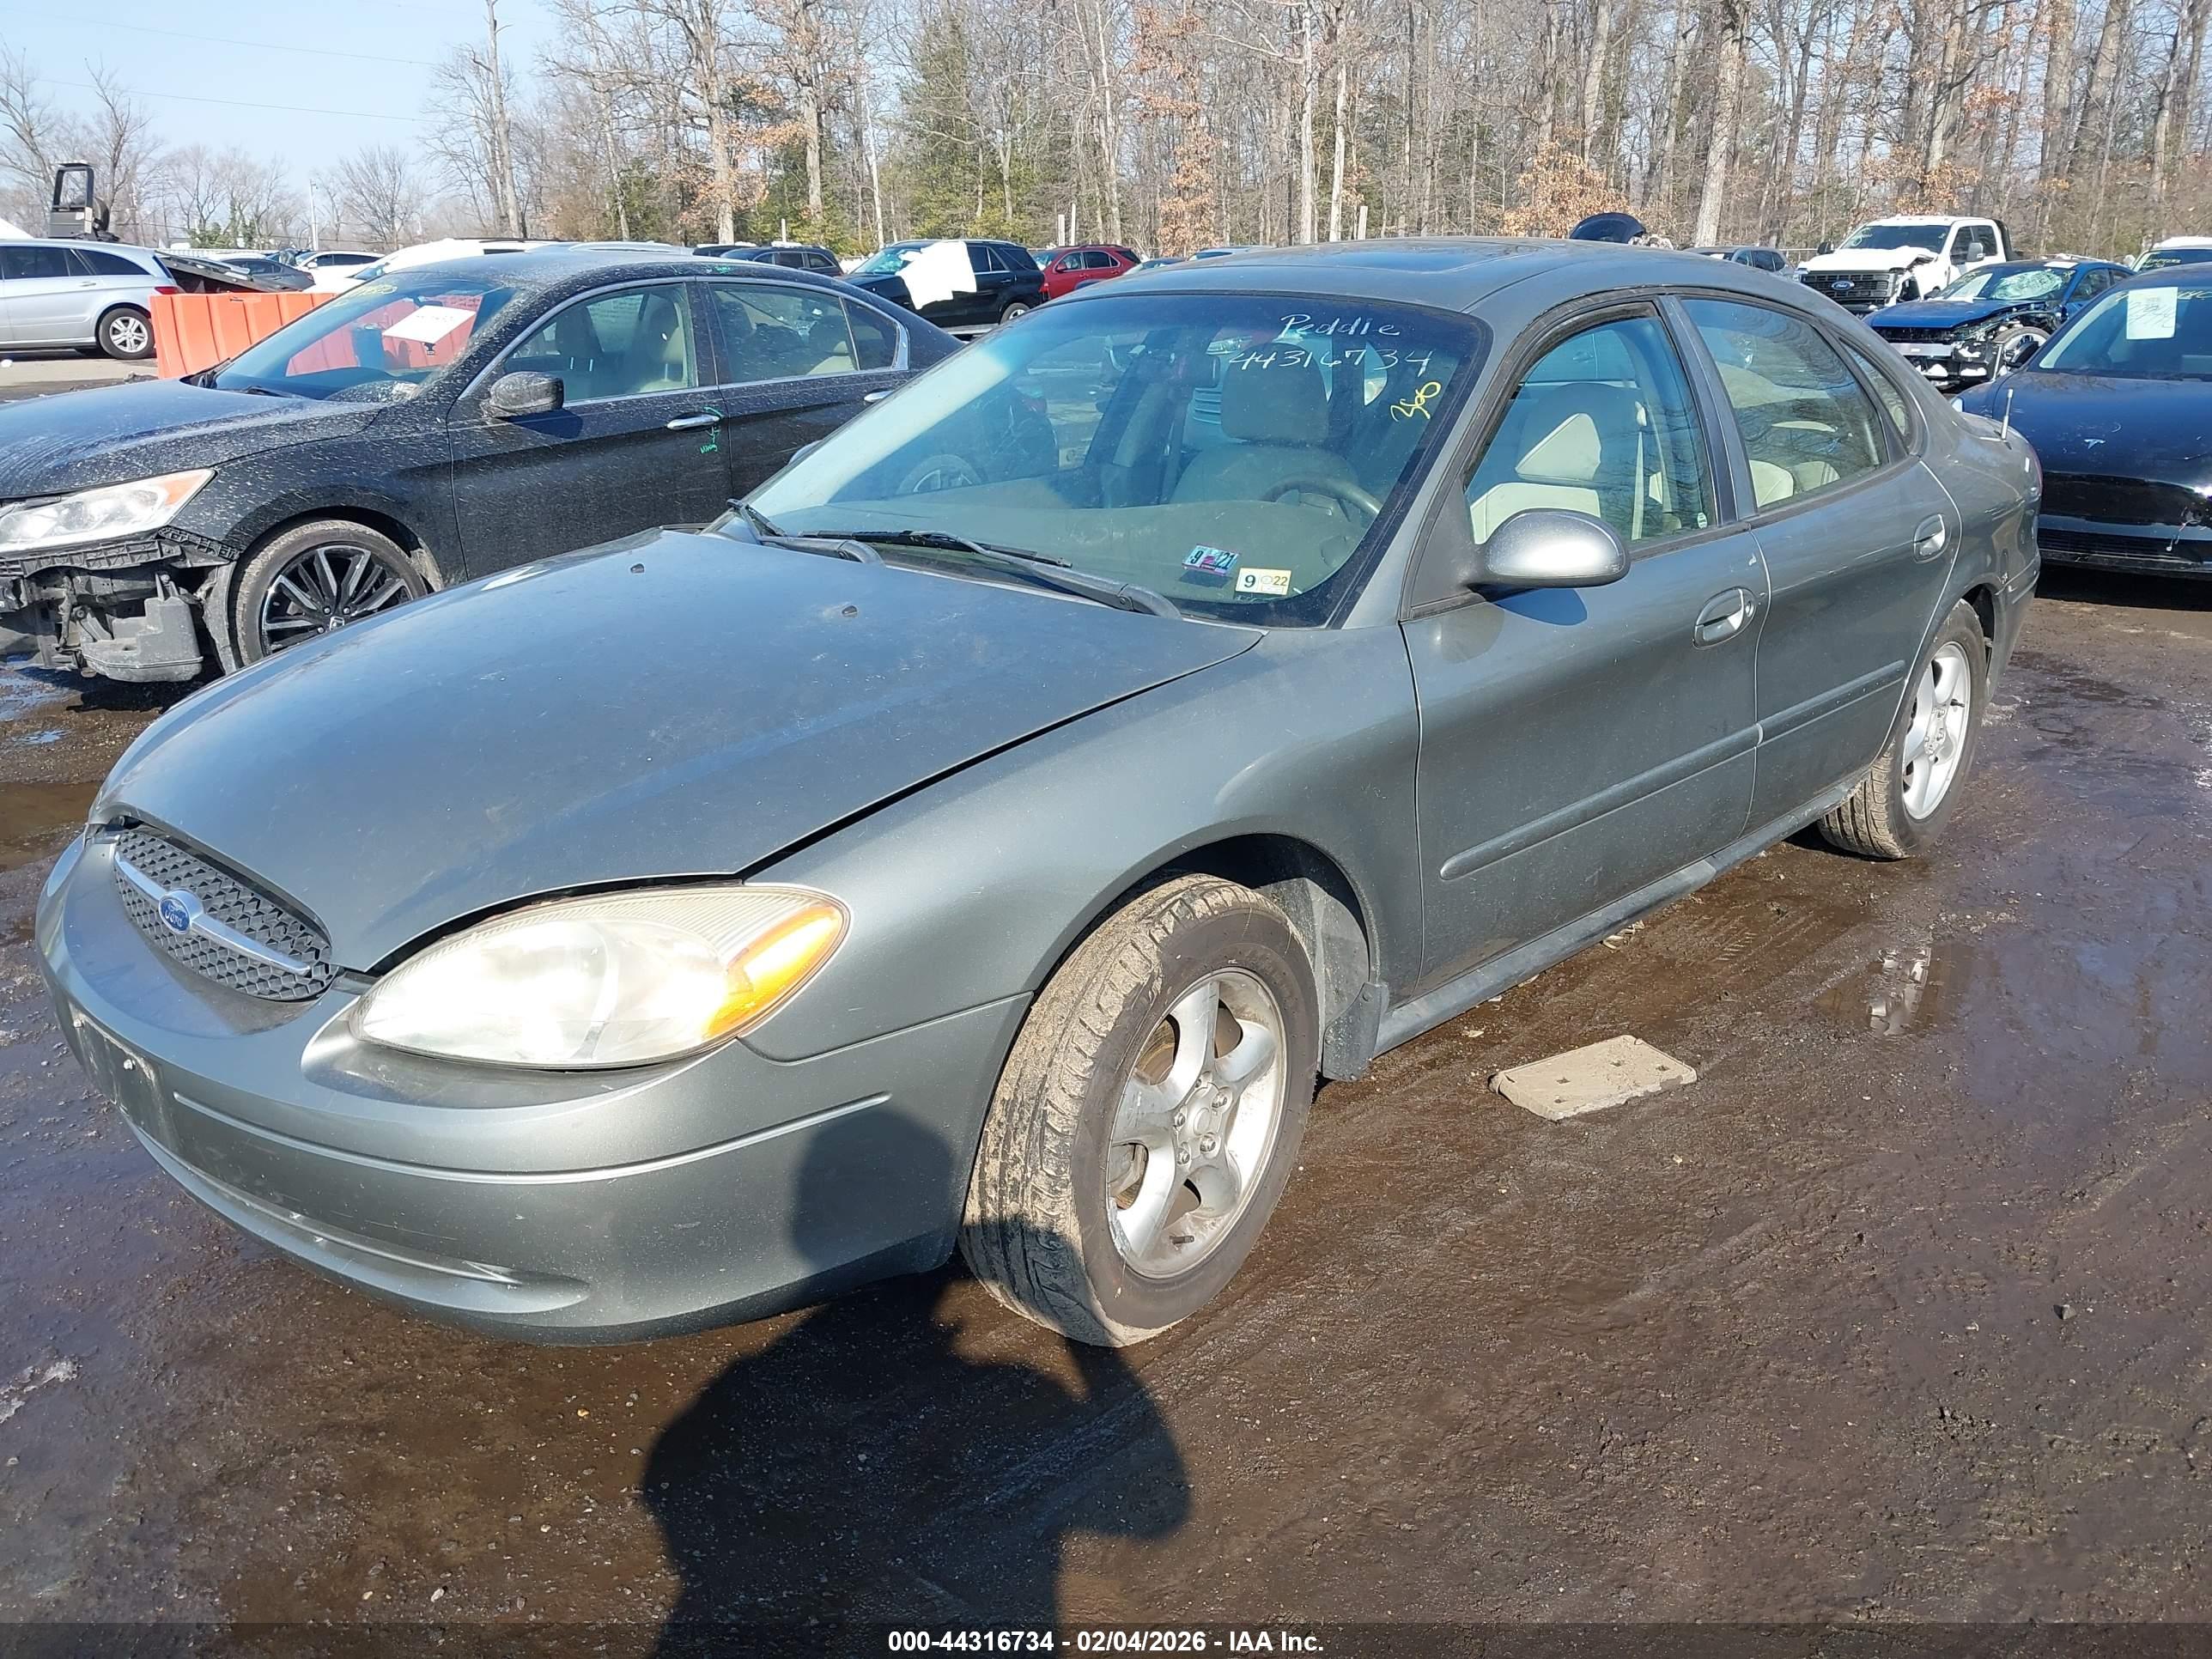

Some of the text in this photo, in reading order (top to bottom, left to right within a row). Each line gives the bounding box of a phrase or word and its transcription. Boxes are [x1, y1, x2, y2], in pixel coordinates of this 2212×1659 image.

[1229, 348, 1434, 378] 44316734
[1190, 550, 1236, 570] 9 21
[1243, 574, 1256, 588] 9
[1273, 575, 1288, 586] 22
